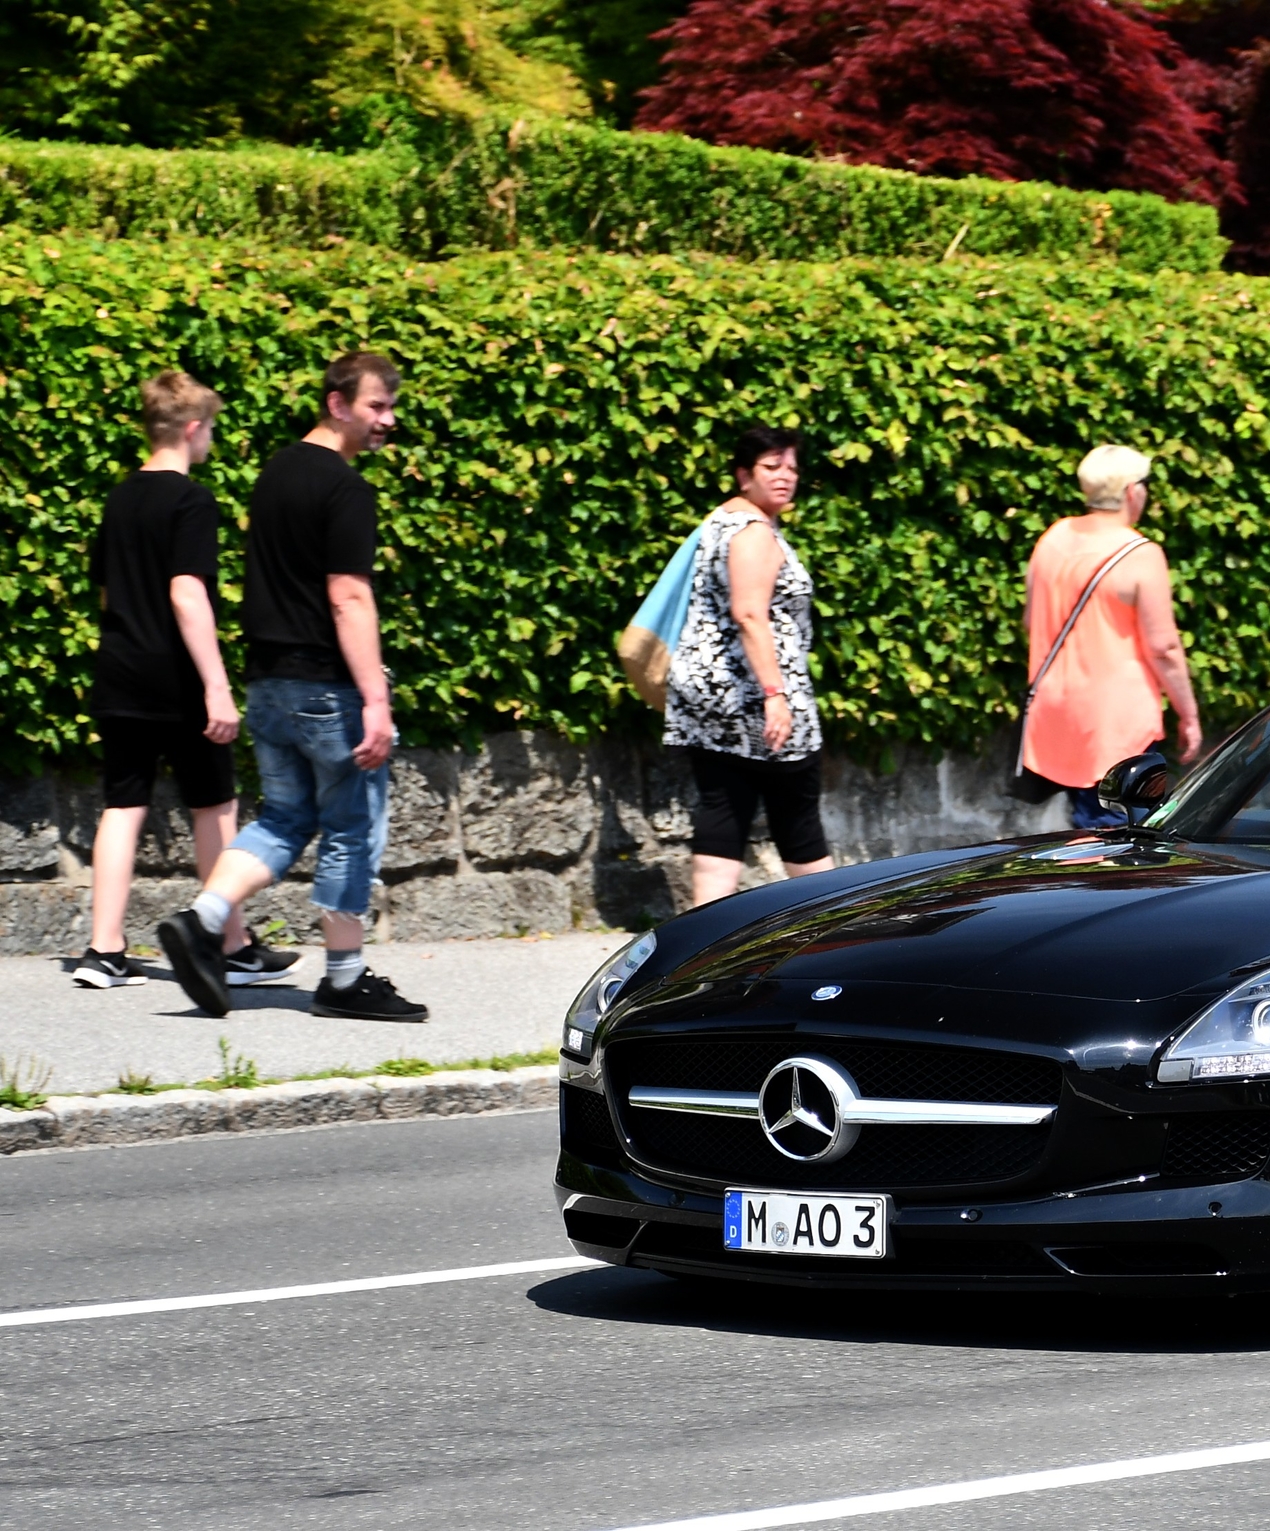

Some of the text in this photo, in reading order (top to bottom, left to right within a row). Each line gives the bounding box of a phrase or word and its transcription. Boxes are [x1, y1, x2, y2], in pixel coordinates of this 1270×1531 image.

[729, 1225, 737, 1238] D
[747, 1200, 767, 1244] M
[853, 1205, 875, 1248] 3
